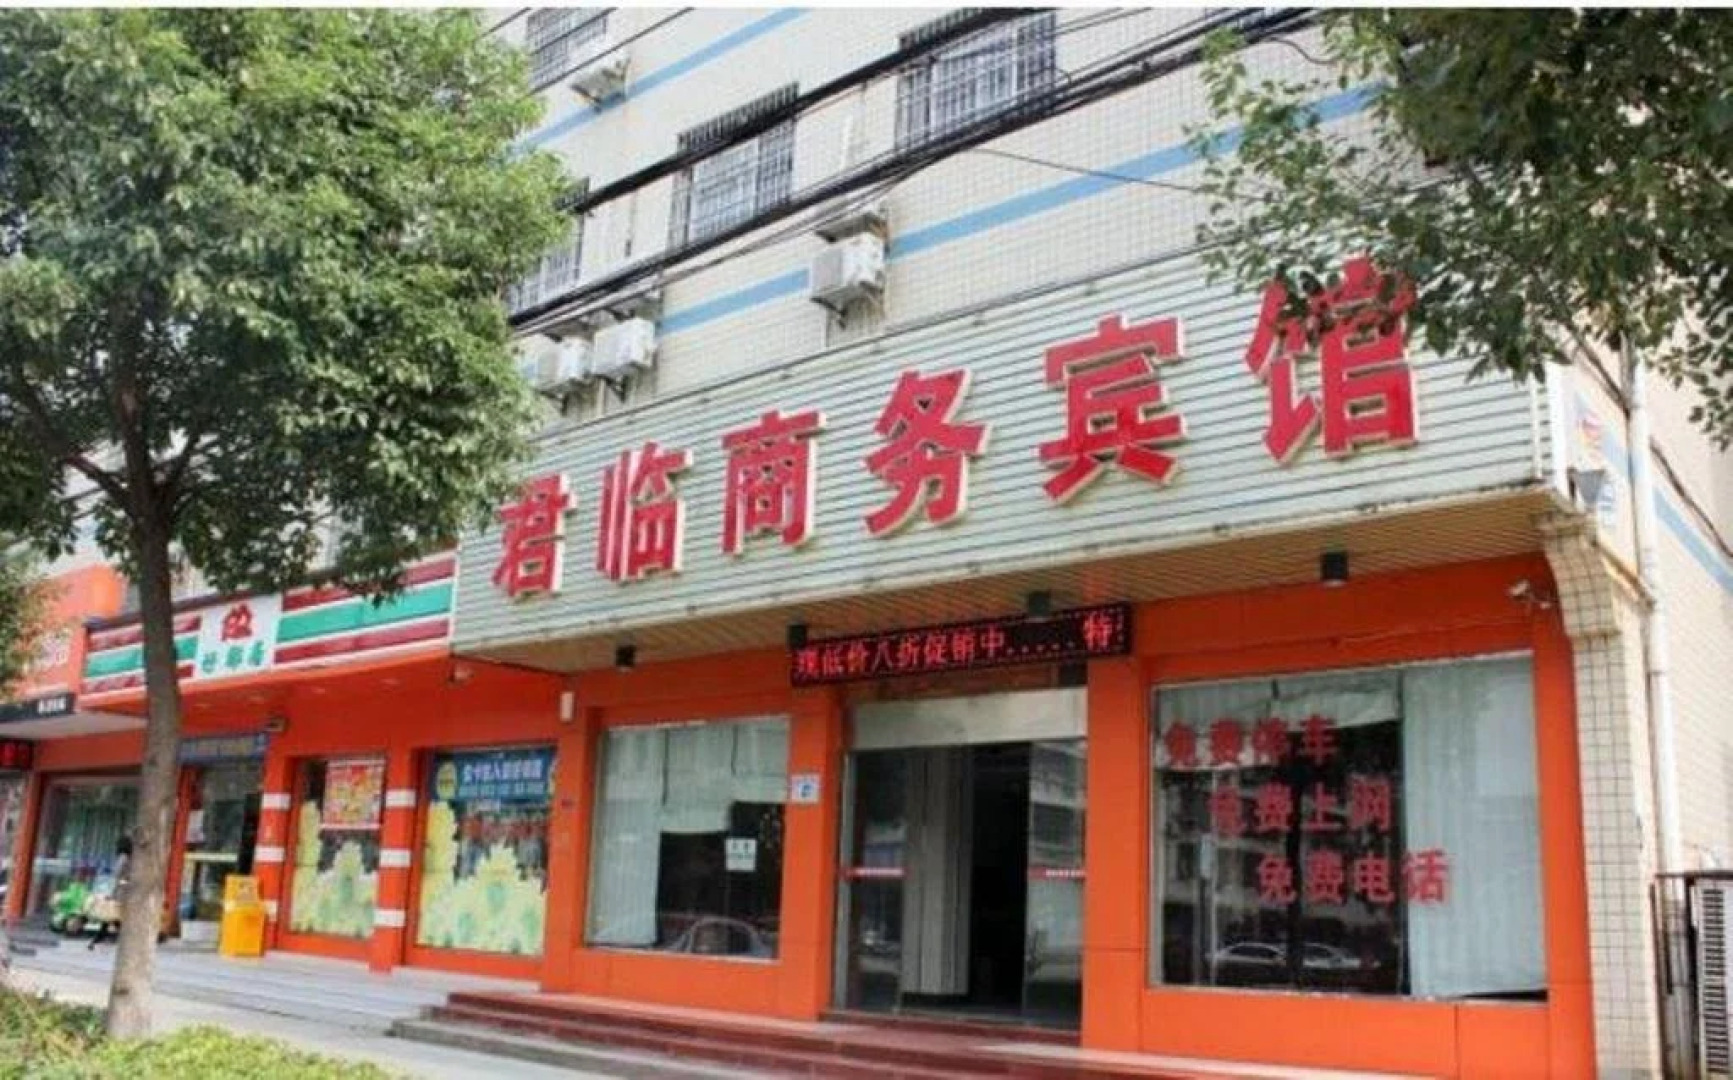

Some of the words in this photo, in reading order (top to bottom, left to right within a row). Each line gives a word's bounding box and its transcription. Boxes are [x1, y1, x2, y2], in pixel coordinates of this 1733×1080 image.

[491, 250, 1418, 600] 君临商务宾馆
[1207, 773, 1392, 838] 免费上网
[1256, 847, 1450, 906] 免费电话
